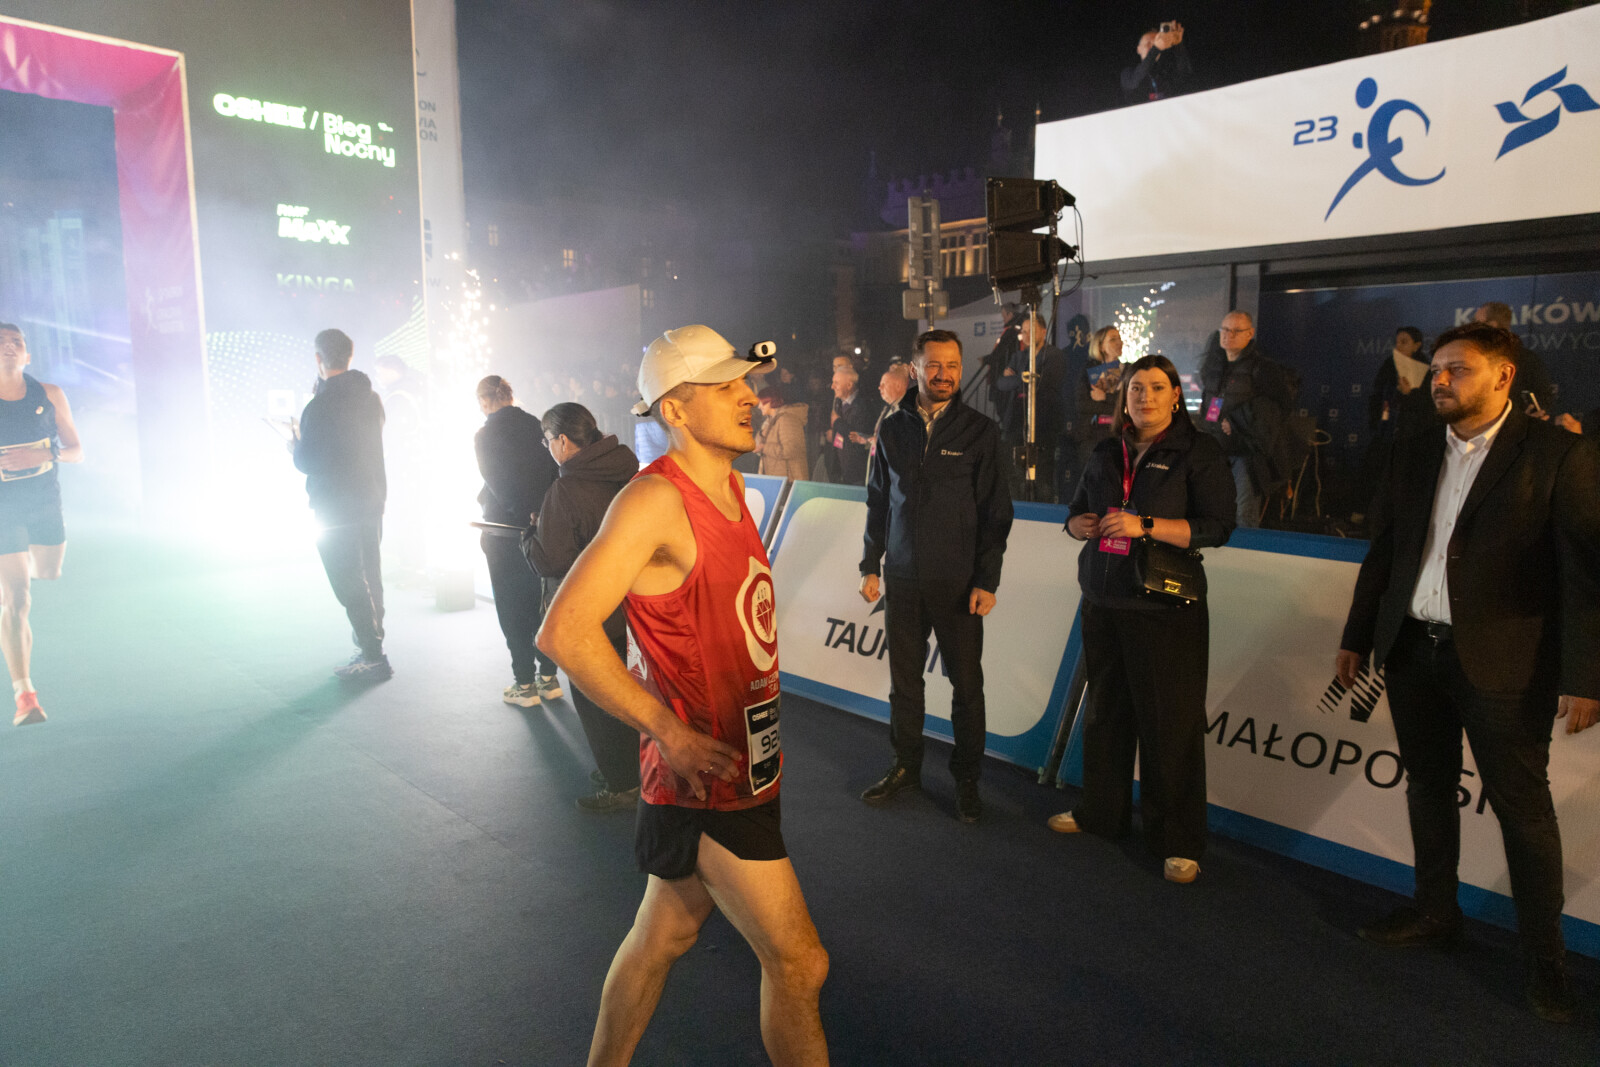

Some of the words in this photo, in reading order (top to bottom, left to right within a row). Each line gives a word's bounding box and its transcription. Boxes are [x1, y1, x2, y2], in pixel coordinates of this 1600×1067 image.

[323, 112, 371, 144] Bieg
[1293, 115, 1339, 146] 23
[324, 133, 395, 168] Nocny
[1454, 296, 1600, 327] KKÓW
